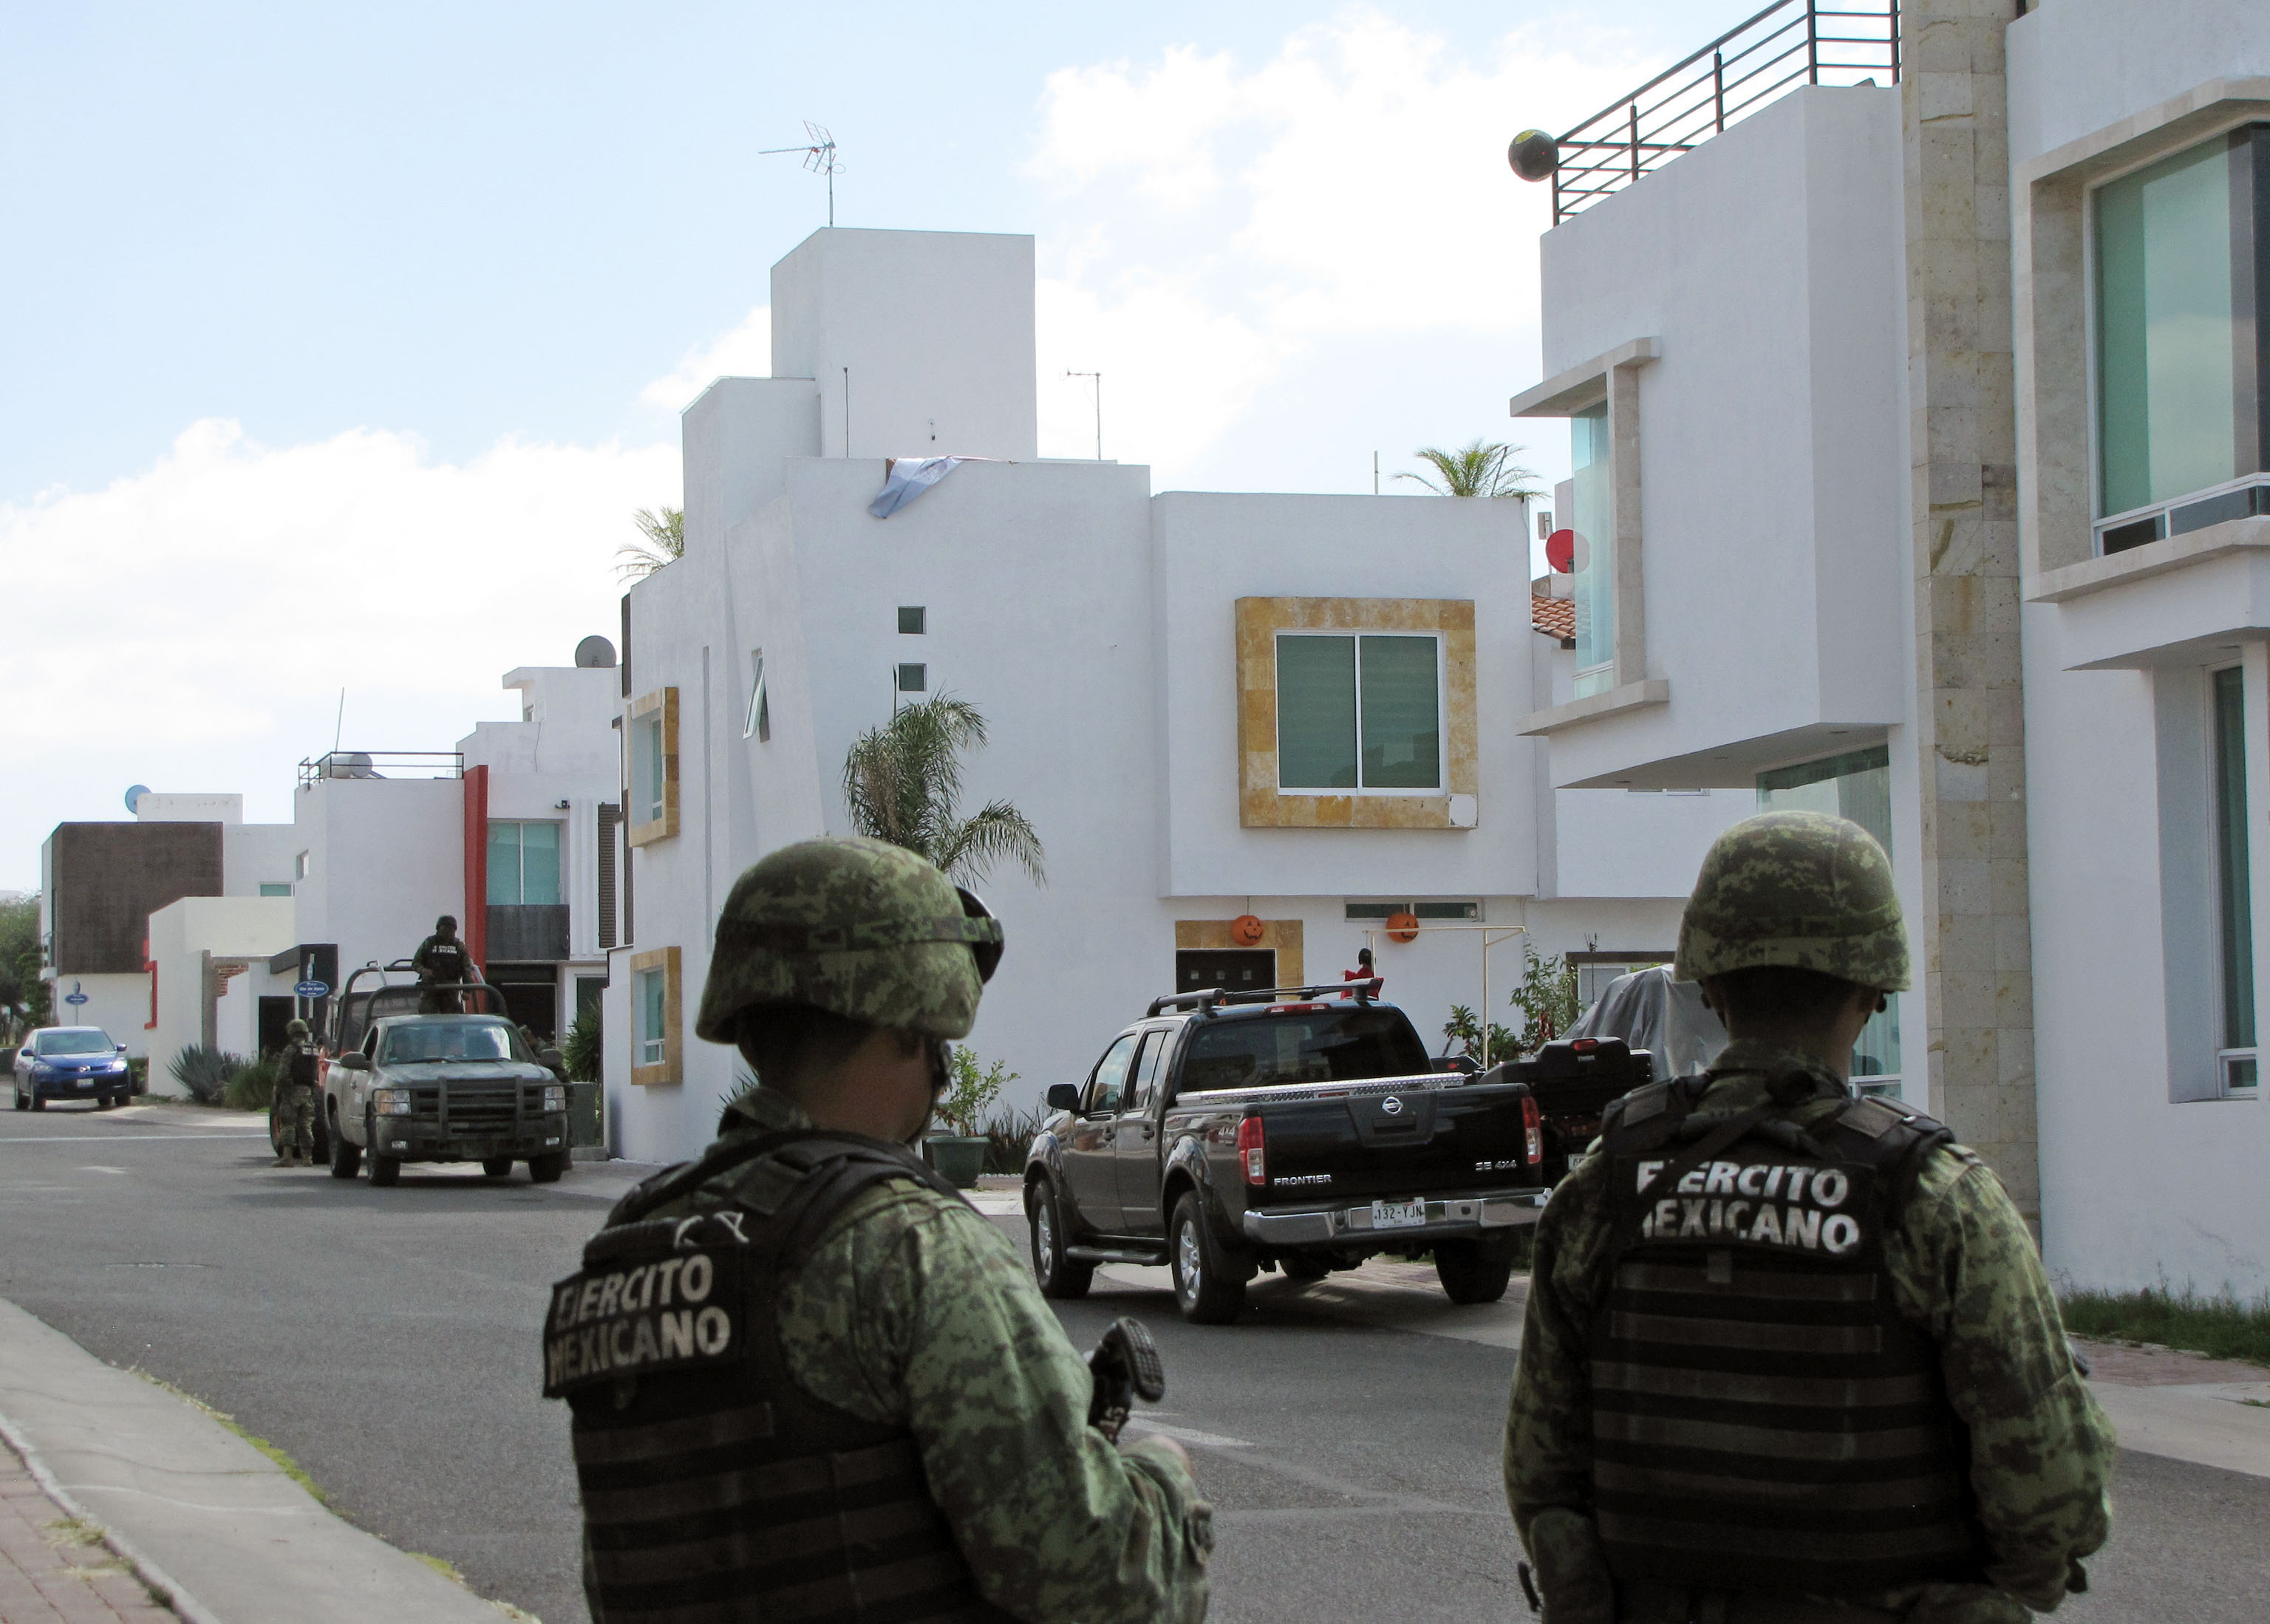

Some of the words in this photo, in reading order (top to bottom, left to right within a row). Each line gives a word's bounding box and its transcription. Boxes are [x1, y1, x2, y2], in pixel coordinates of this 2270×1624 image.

[1475, 1161, 1492, 1170] SE
[1273, 1173, 1332, 1186] FRONTIER
[1636, 1160, 1848, 1207] EERCITO
[1377, 1205, 1422, 1220] 132-YJN
[547, 1305, 731, 1388] MEXICANO
